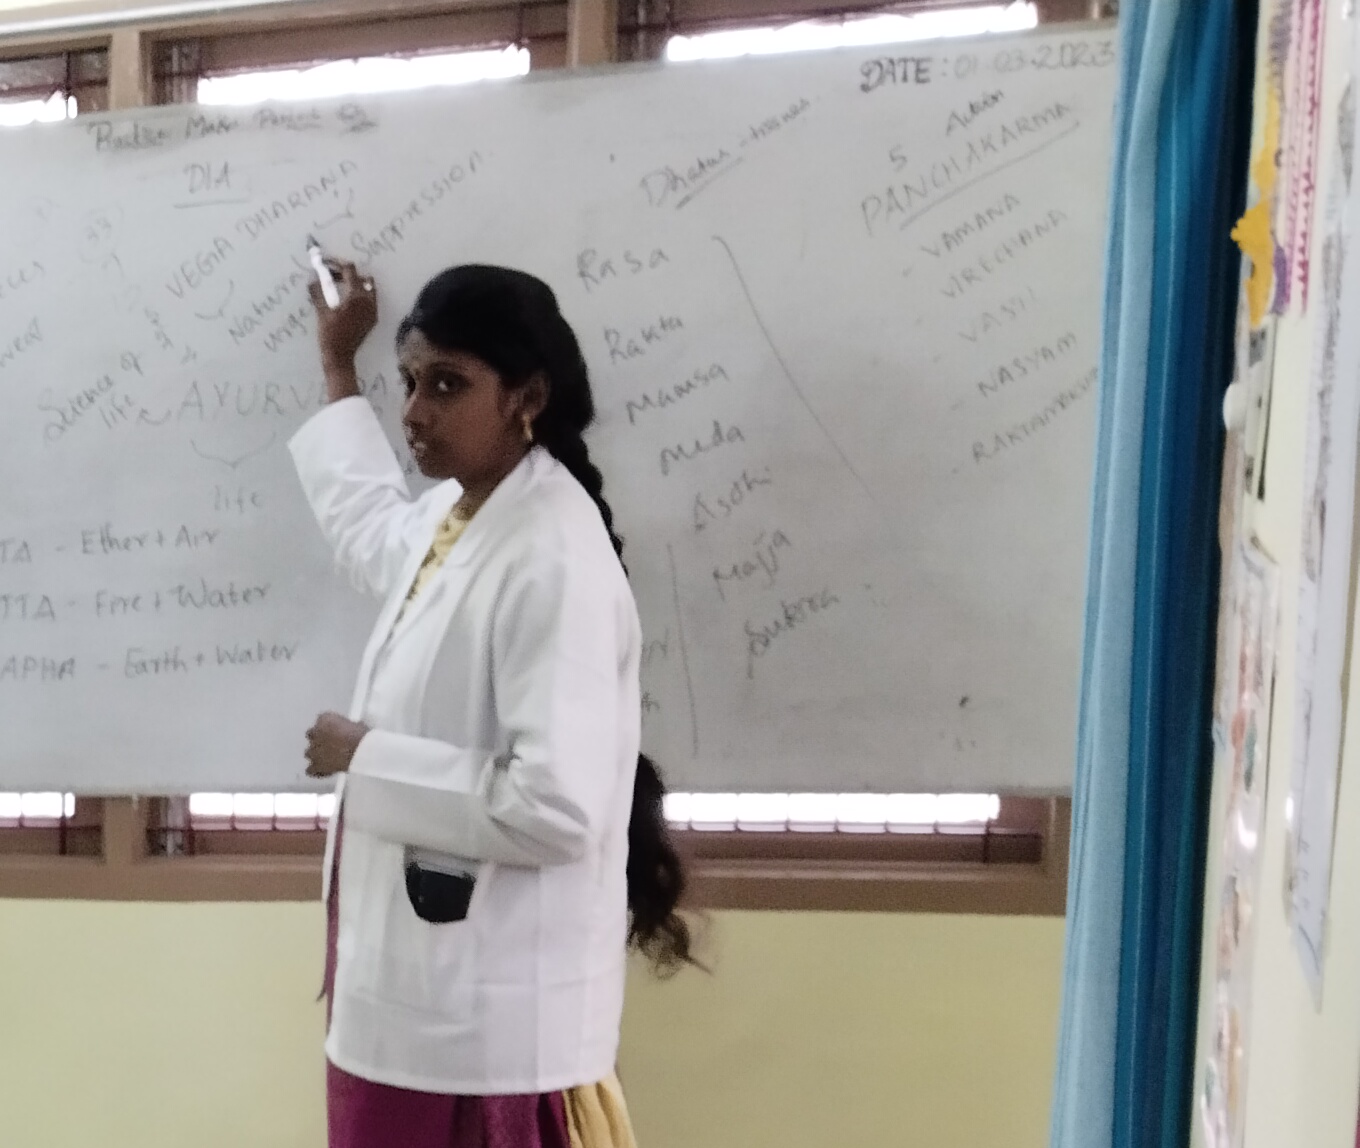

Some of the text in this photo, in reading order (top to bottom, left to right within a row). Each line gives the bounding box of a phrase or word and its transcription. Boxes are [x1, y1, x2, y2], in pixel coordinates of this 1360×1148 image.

[860, 101, 1072, 238] PANCHAKARMA
[919, 192, 1021, 258] VAMANA
[576, 247, 671, 291] Rasa
